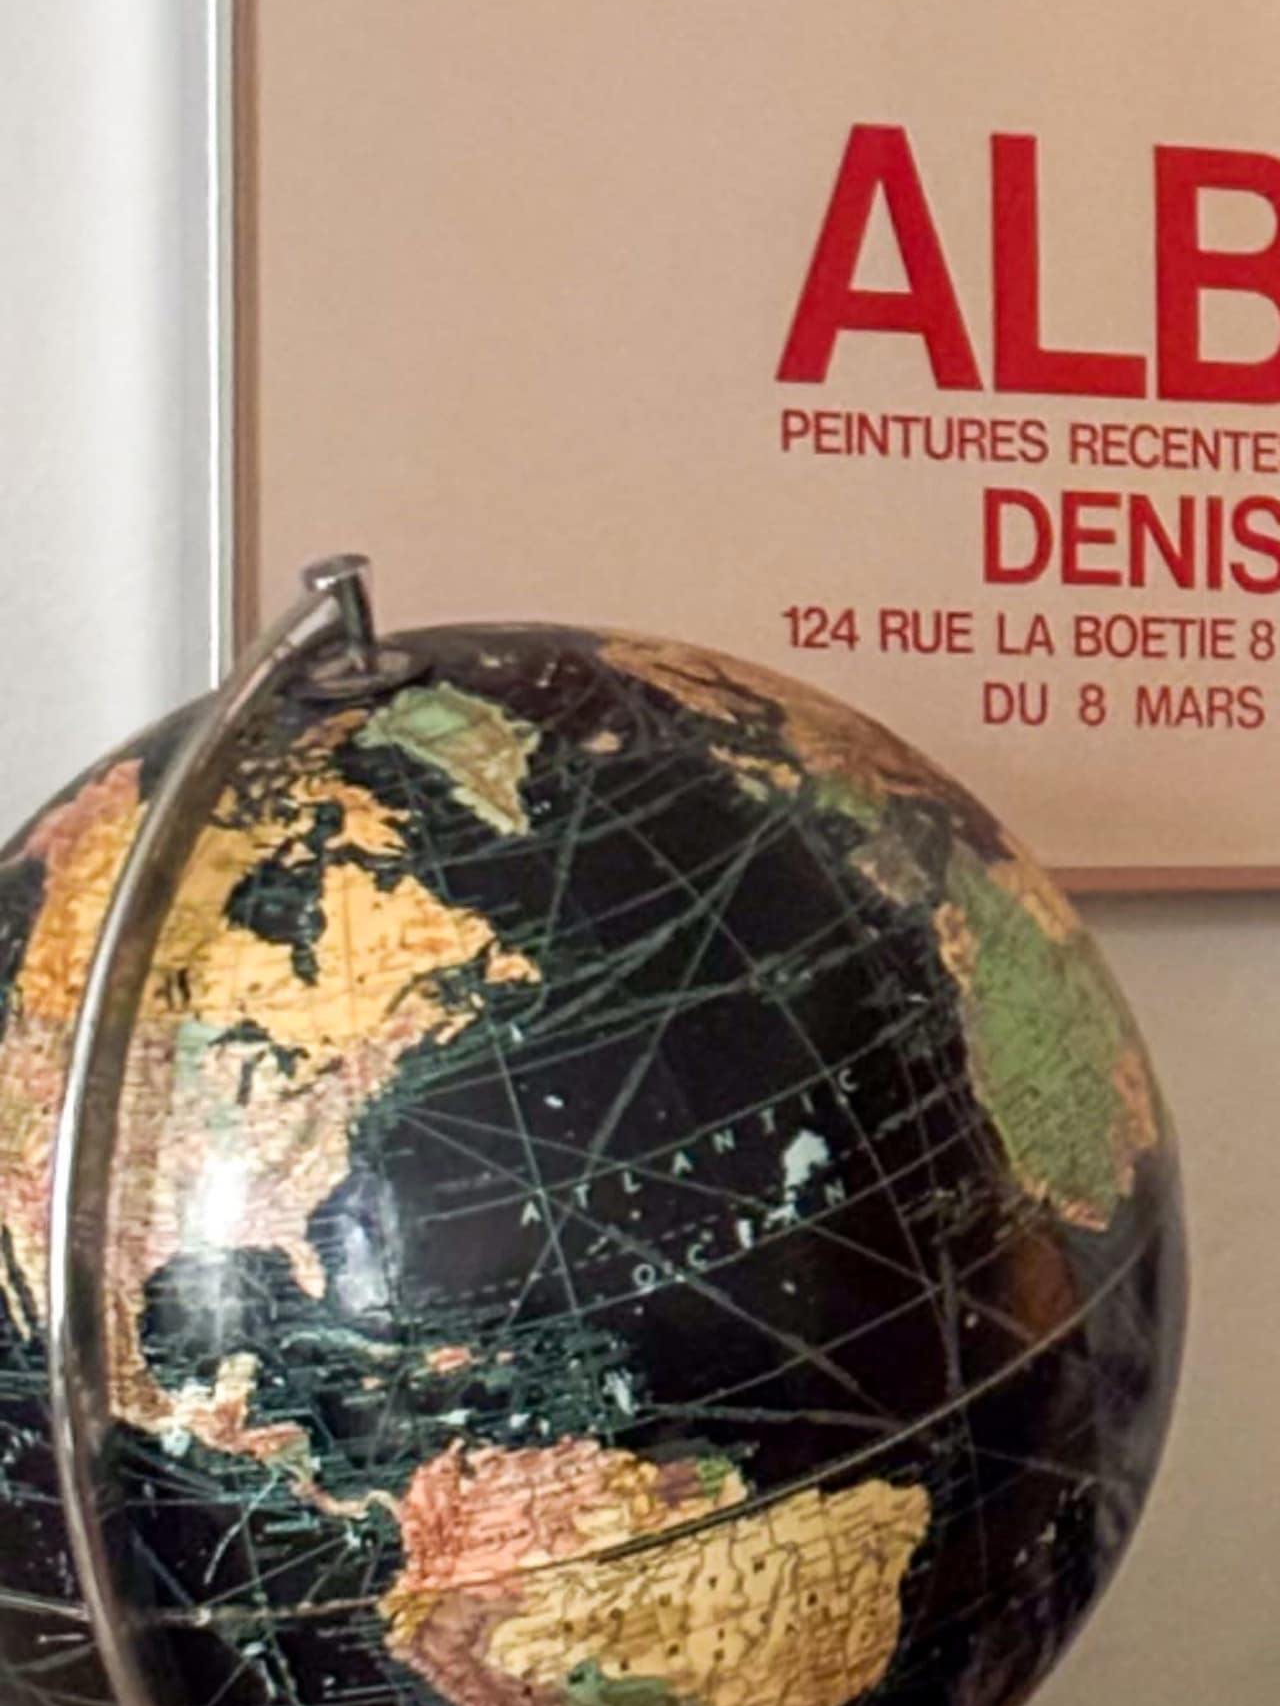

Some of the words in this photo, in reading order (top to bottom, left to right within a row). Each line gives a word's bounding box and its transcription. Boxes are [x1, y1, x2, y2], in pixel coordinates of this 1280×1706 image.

[780, 408, 1049, 464] PEINTURES
[782, 605, 860, 649] 124
[878, 608, 972, 654] RUE
[994, 612, 1056, 656] LA
[1073, 614, 1236, 660] BOETIE
[1248, 618, 1276, 662] 8
[982, 680, 1050, 726] DU
[1077, 683, 1108, 726] 8
[1134, 684, 1266, 730] MARS
